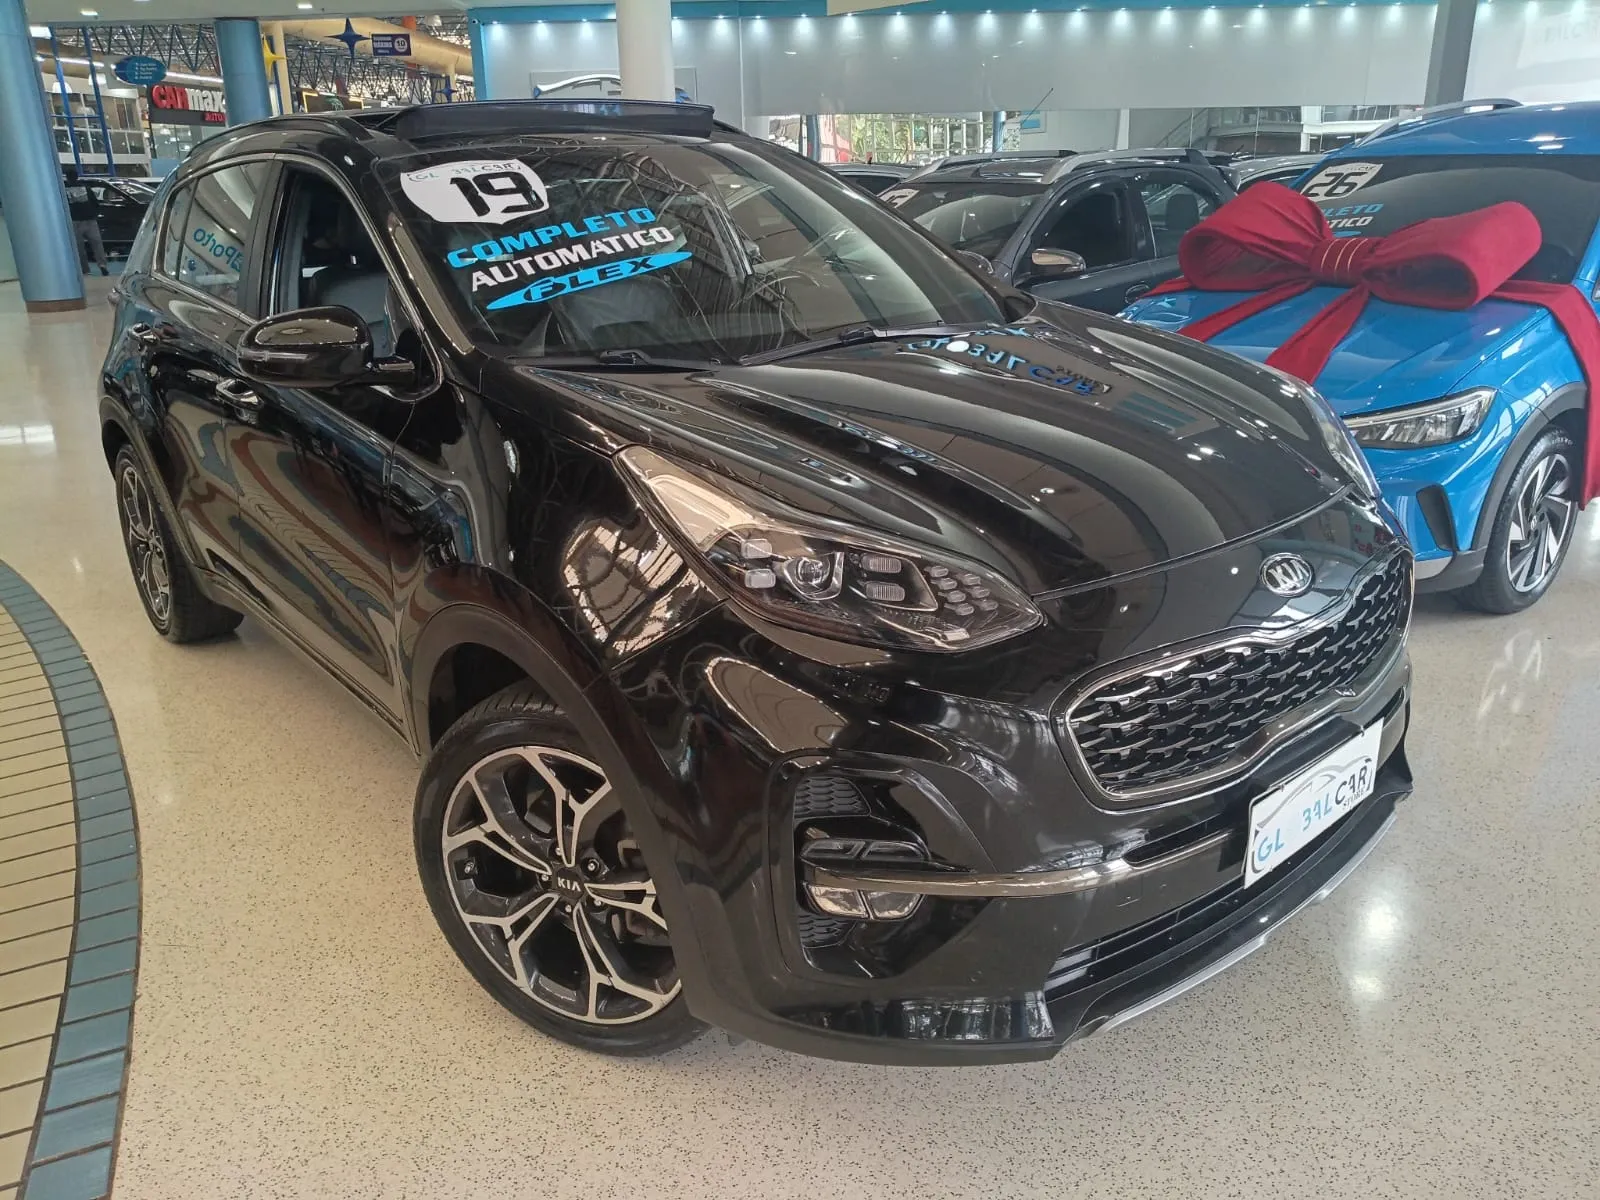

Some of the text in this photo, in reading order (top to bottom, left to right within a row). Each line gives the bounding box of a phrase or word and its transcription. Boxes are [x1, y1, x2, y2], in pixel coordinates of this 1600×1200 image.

[450, 171, 545, 217] 19
[1304, 171, 1368, 198] 26
[446, 207, 657, 269] COMPLETO
[524, 255, 658, 302] FLEX
[1266, 559, 1309, 590] KIA
[557, 876, 581, 892] KIA
